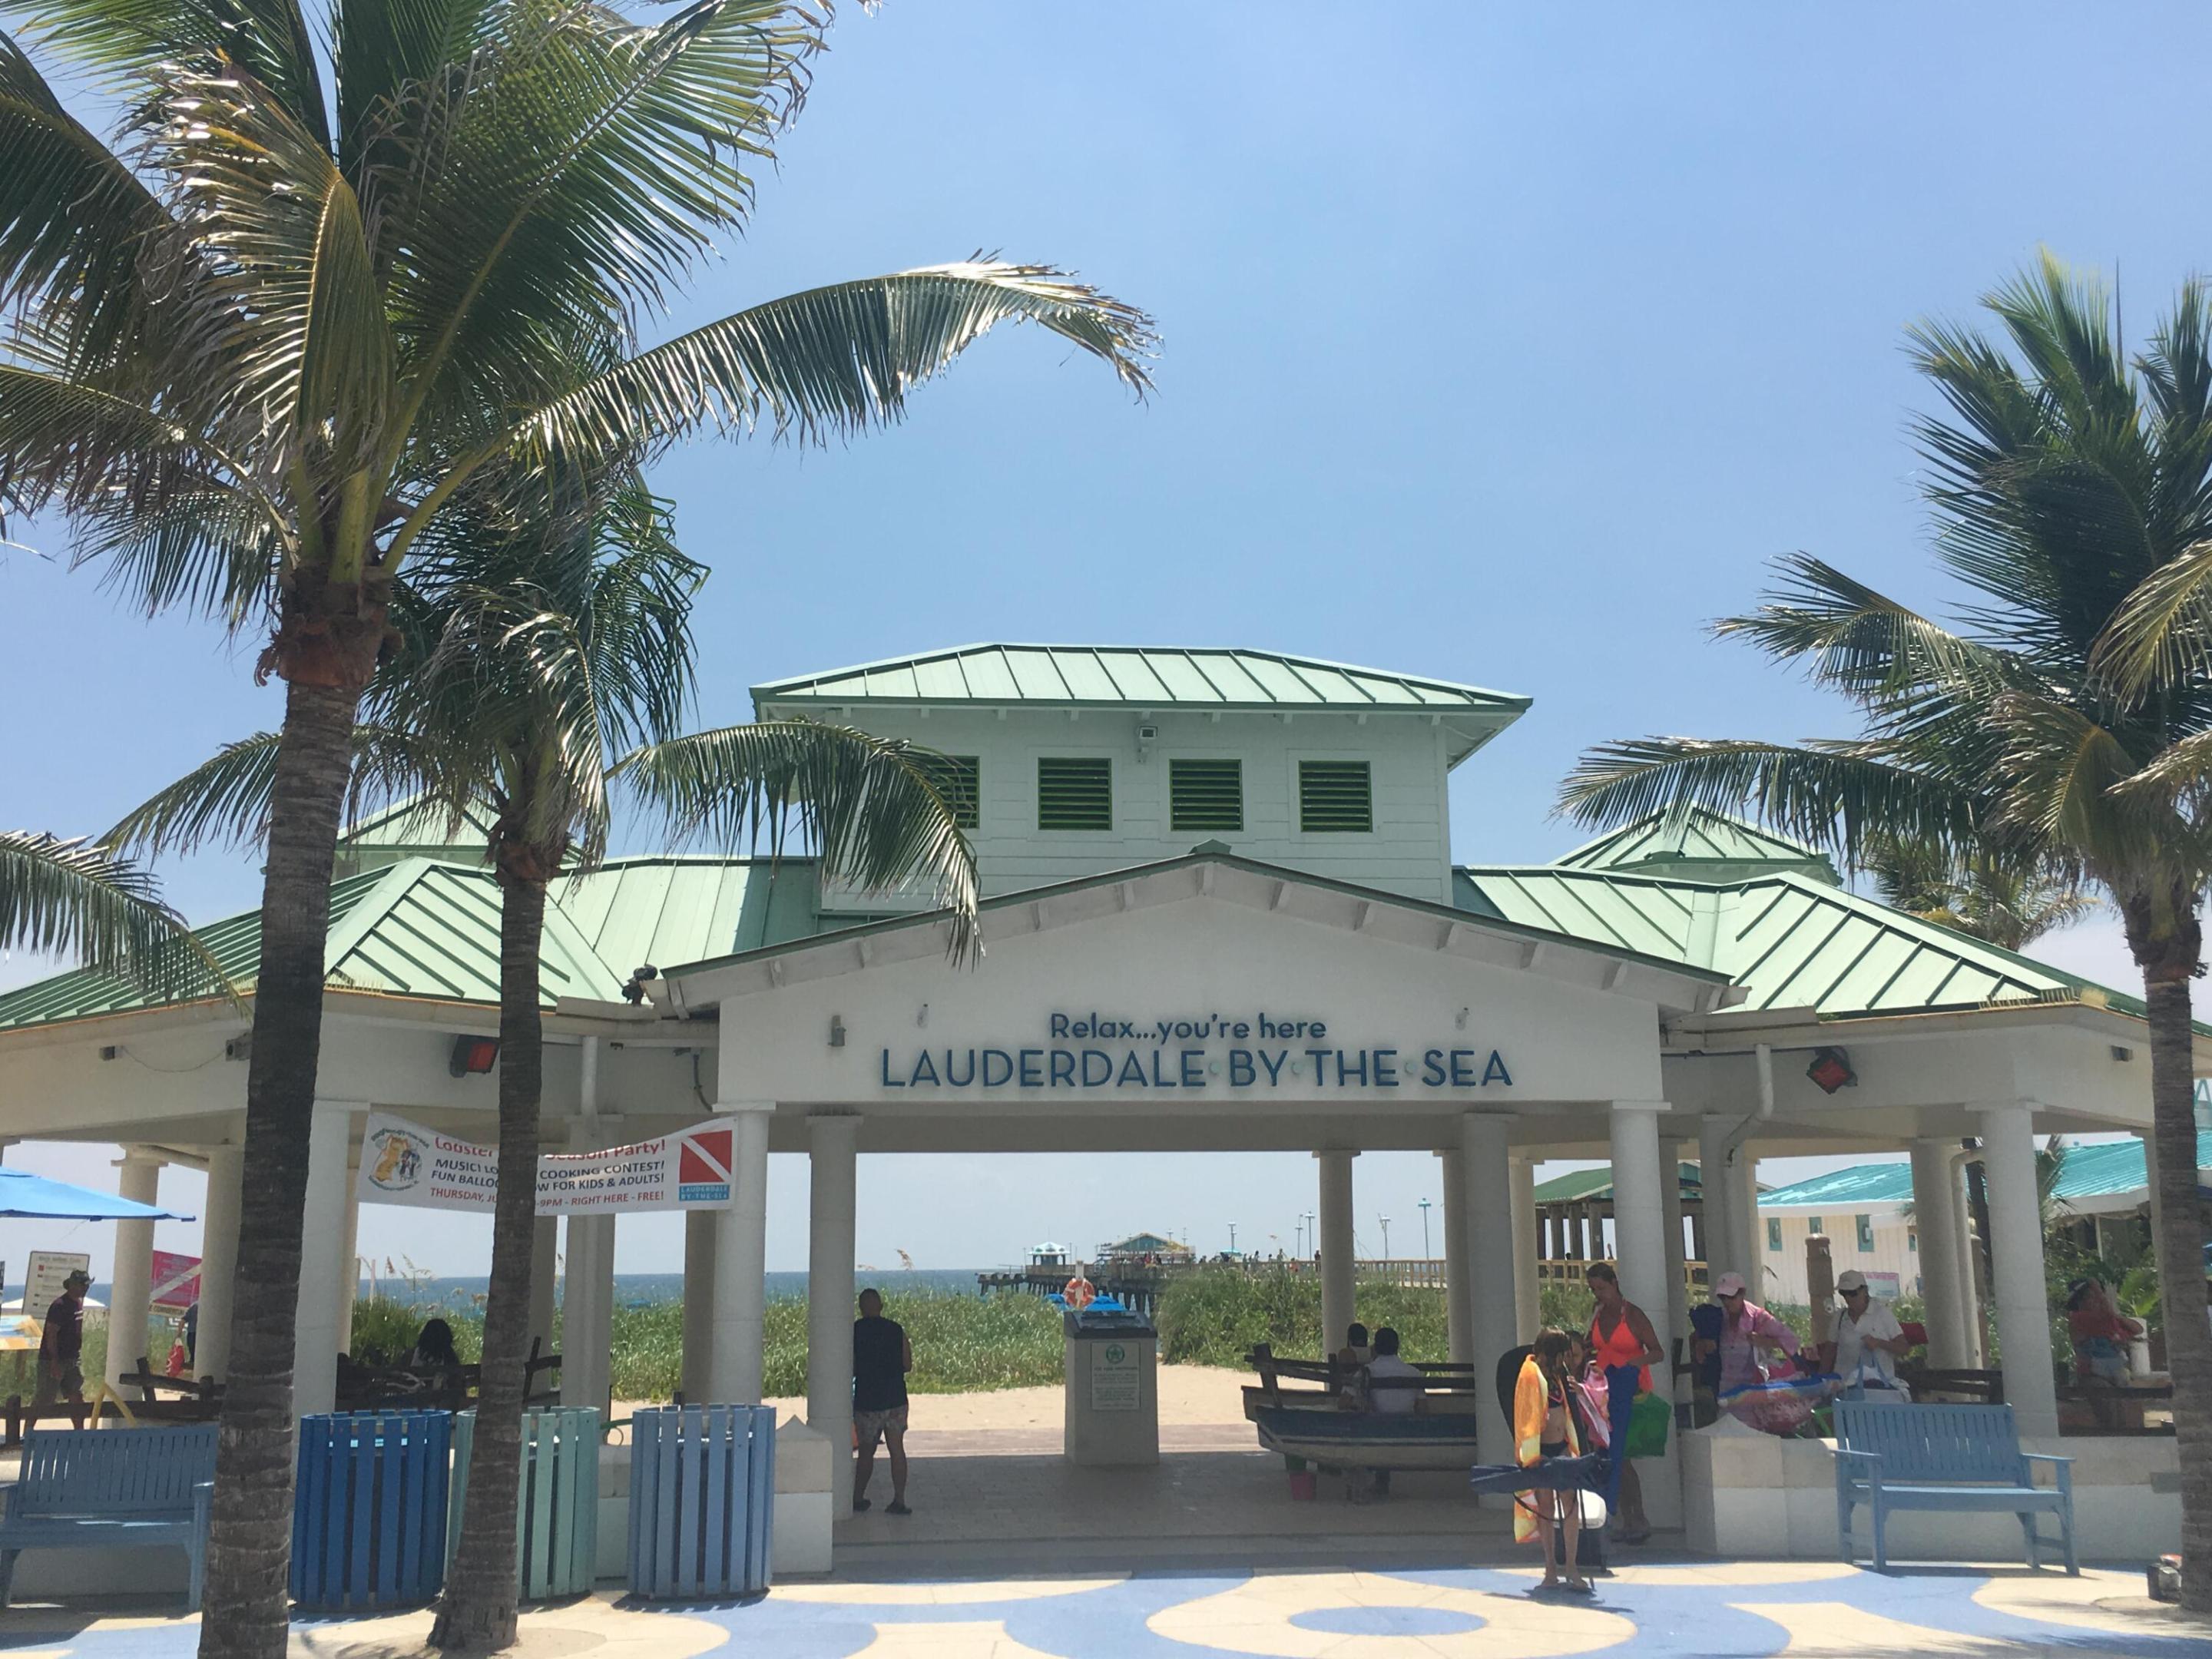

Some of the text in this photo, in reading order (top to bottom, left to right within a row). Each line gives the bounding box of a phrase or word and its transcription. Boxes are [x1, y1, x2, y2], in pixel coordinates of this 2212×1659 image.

[1050, 1012, 1327, 1045] Relax...you're here
[882, 1048, 1514, 1088] LAUDERDALE BY THE SEA
[614, 1139, 666, 1158] Party!
[435, 1158, 482, 1174] MUSIC!
[540, 1167, 601, 1180] COOKING
[604, 1161, 665, 1174] CONTEST!
[431, 1170, 456, 1183] FUN
[552, 1180, 575, 1191] FOR
[578, 1178, 604, 1190] KIDS
[607, 1177, 616, 1187] &
[618, 1173, 665, 1187] ADULTS!
[429, 1187, 485, 1203] THURSDAY,
[537, 1197, 563, 1207] -9PM
[571, 1194, 601, 1206] RIGHT
[603, 1193, 629, 1204] HERE
[637, 1190, 664, 1202] FREE!
